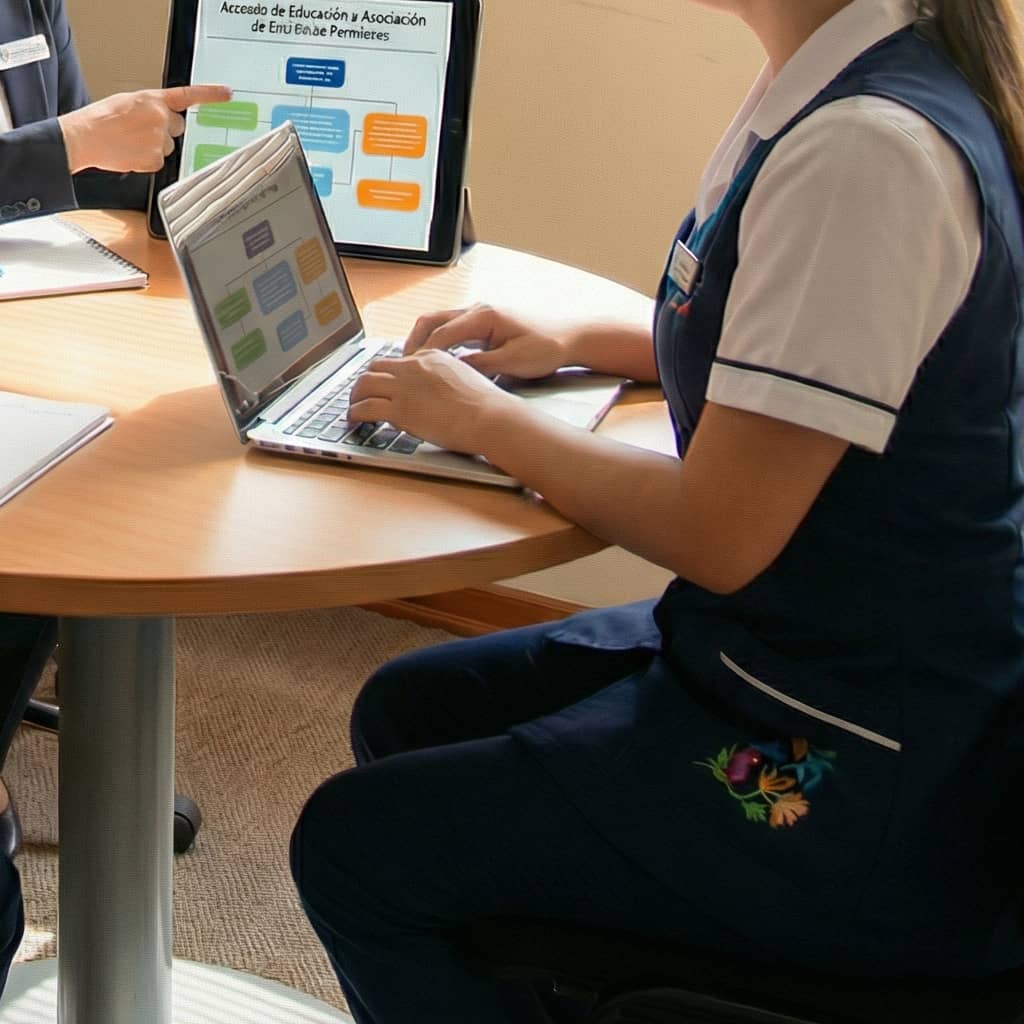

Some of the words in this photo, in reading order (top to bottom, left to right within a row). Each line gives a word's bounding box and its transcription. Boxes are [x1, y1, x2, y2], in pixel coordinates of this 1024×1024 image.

[271, 4, 286, 17] de
[289, 4, 349, 22] Educación
[361, 10, 427, 27] Asociación
[251, 19, 266, 33] de
